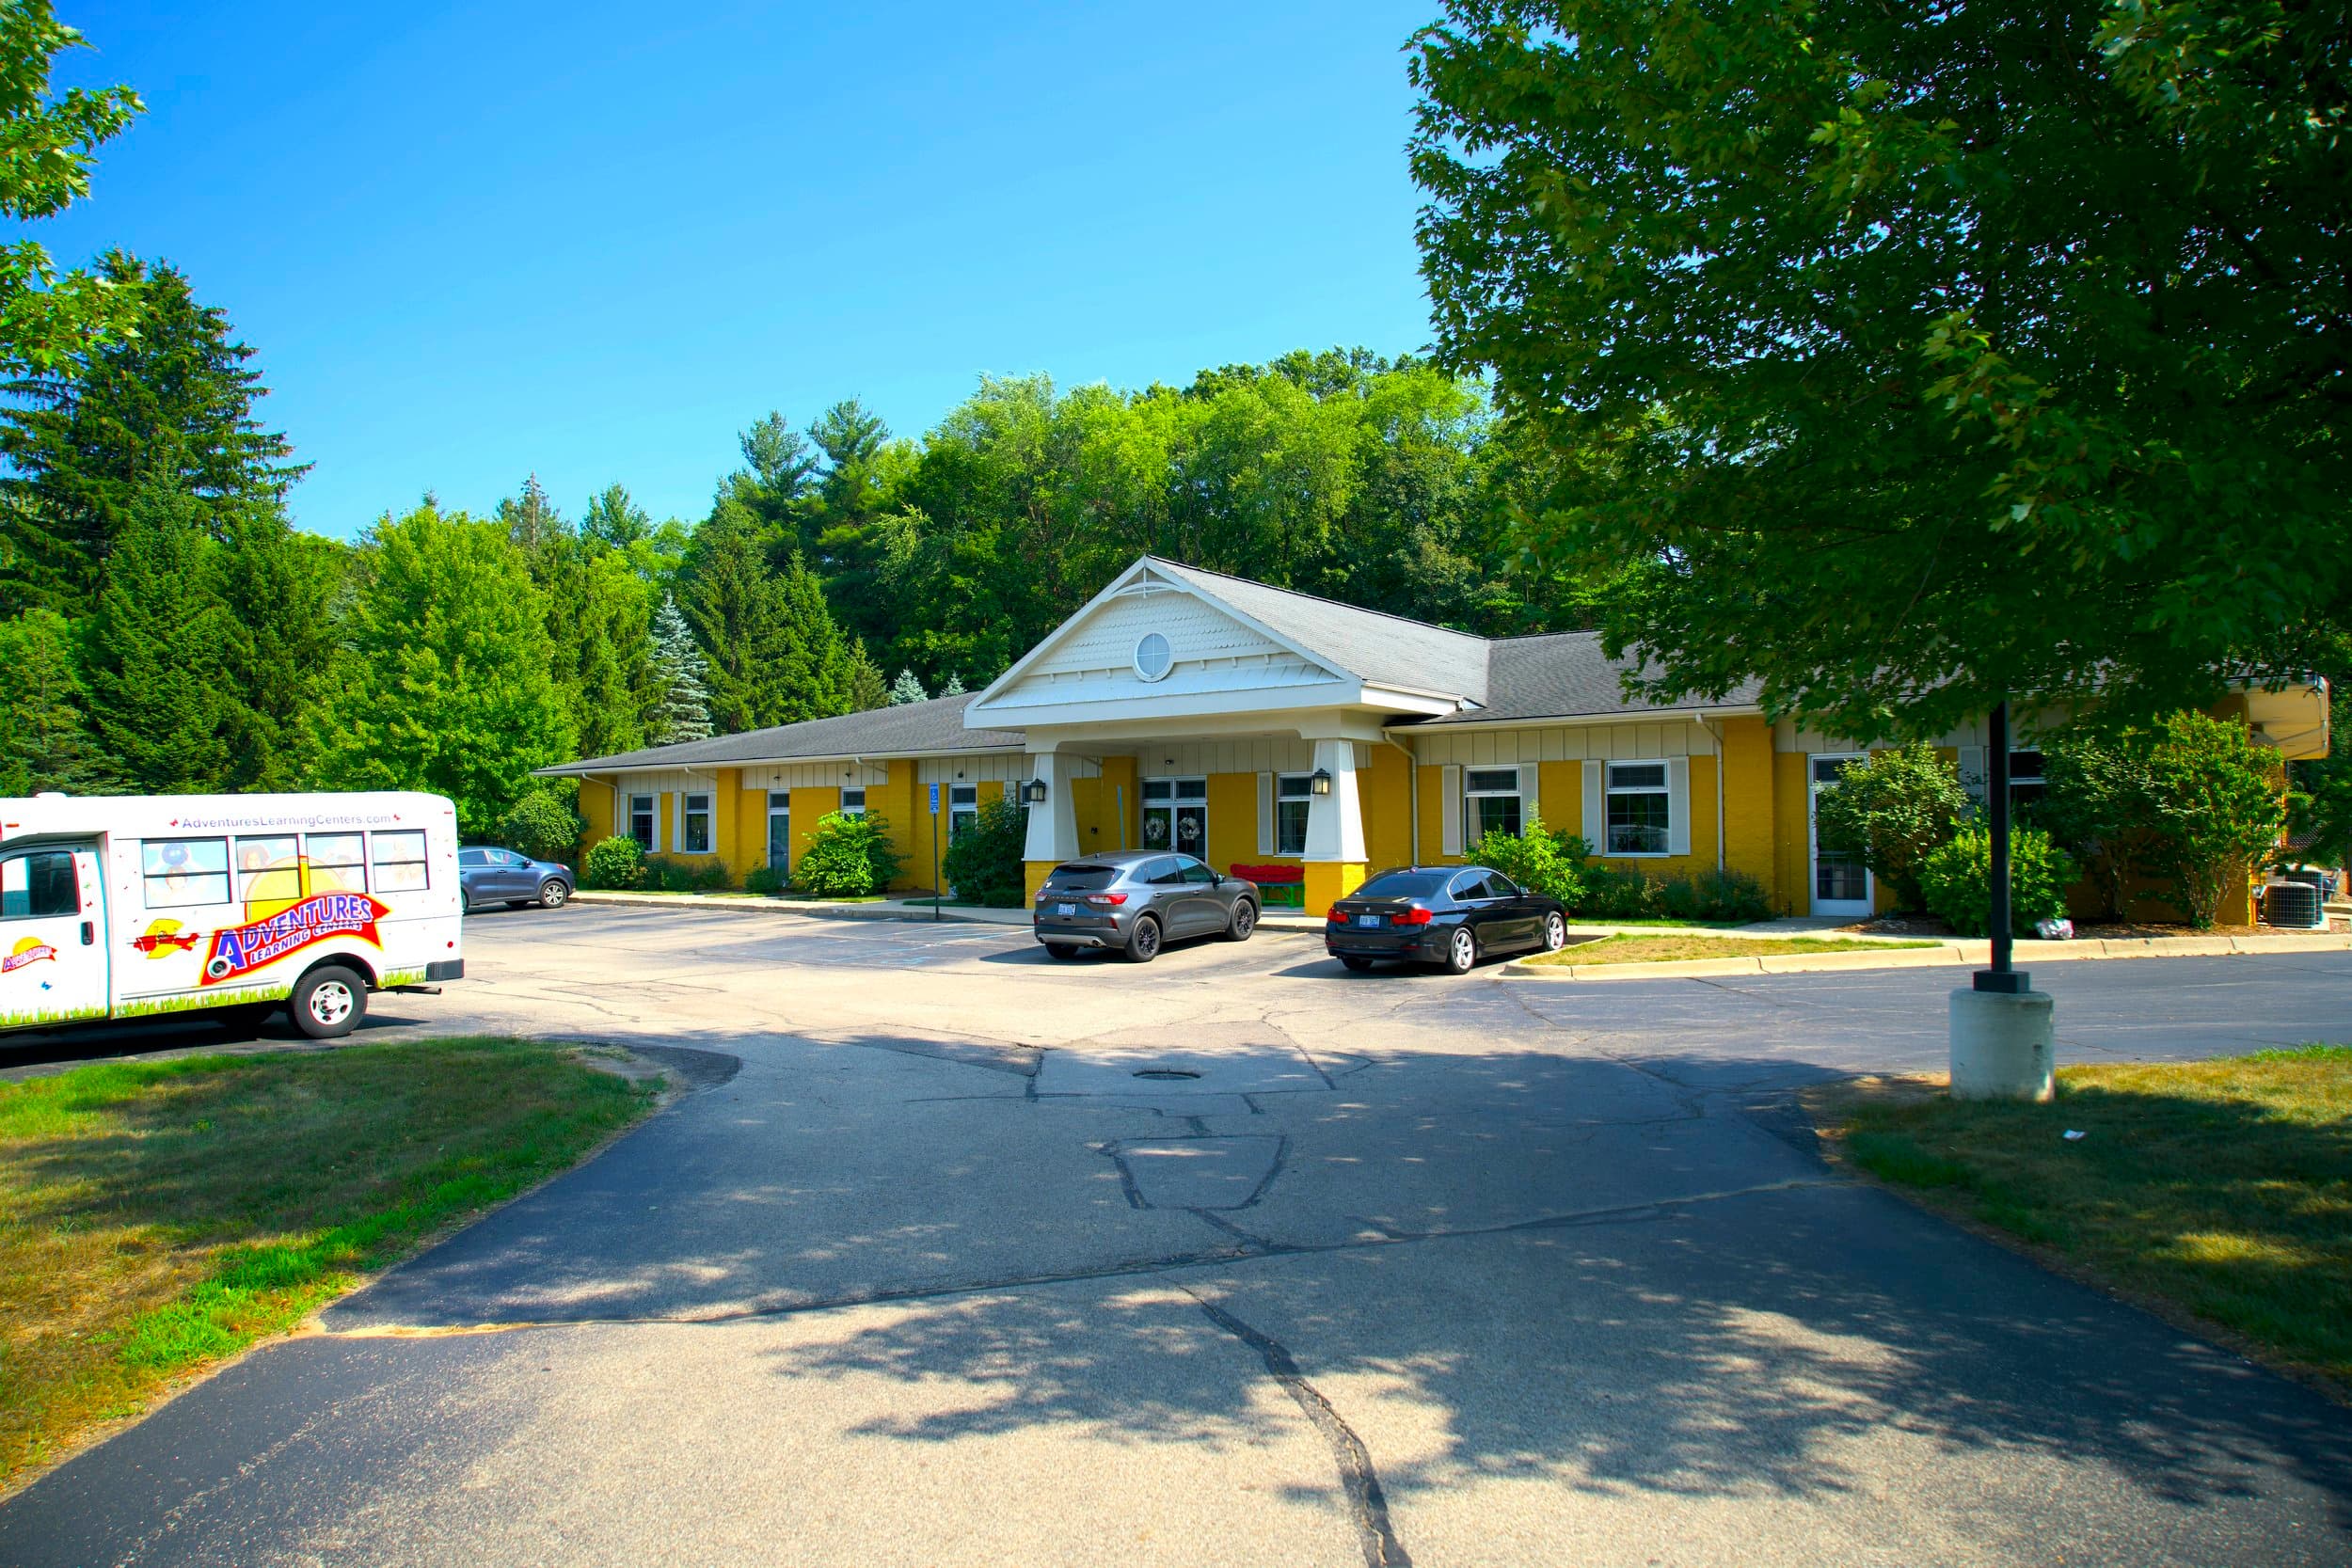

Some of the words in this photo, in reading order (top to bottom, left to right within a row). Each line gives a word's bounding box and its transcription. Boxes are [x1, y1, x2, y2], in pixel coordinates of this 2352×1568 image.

[182, 814, 391, 829] AdventuresLearningCenters.com
[215, 895, 373, 970] ADVENTURES
[250, 929, 311, 965] LEARNING
[312, 920, 363, 937] CENTERS
